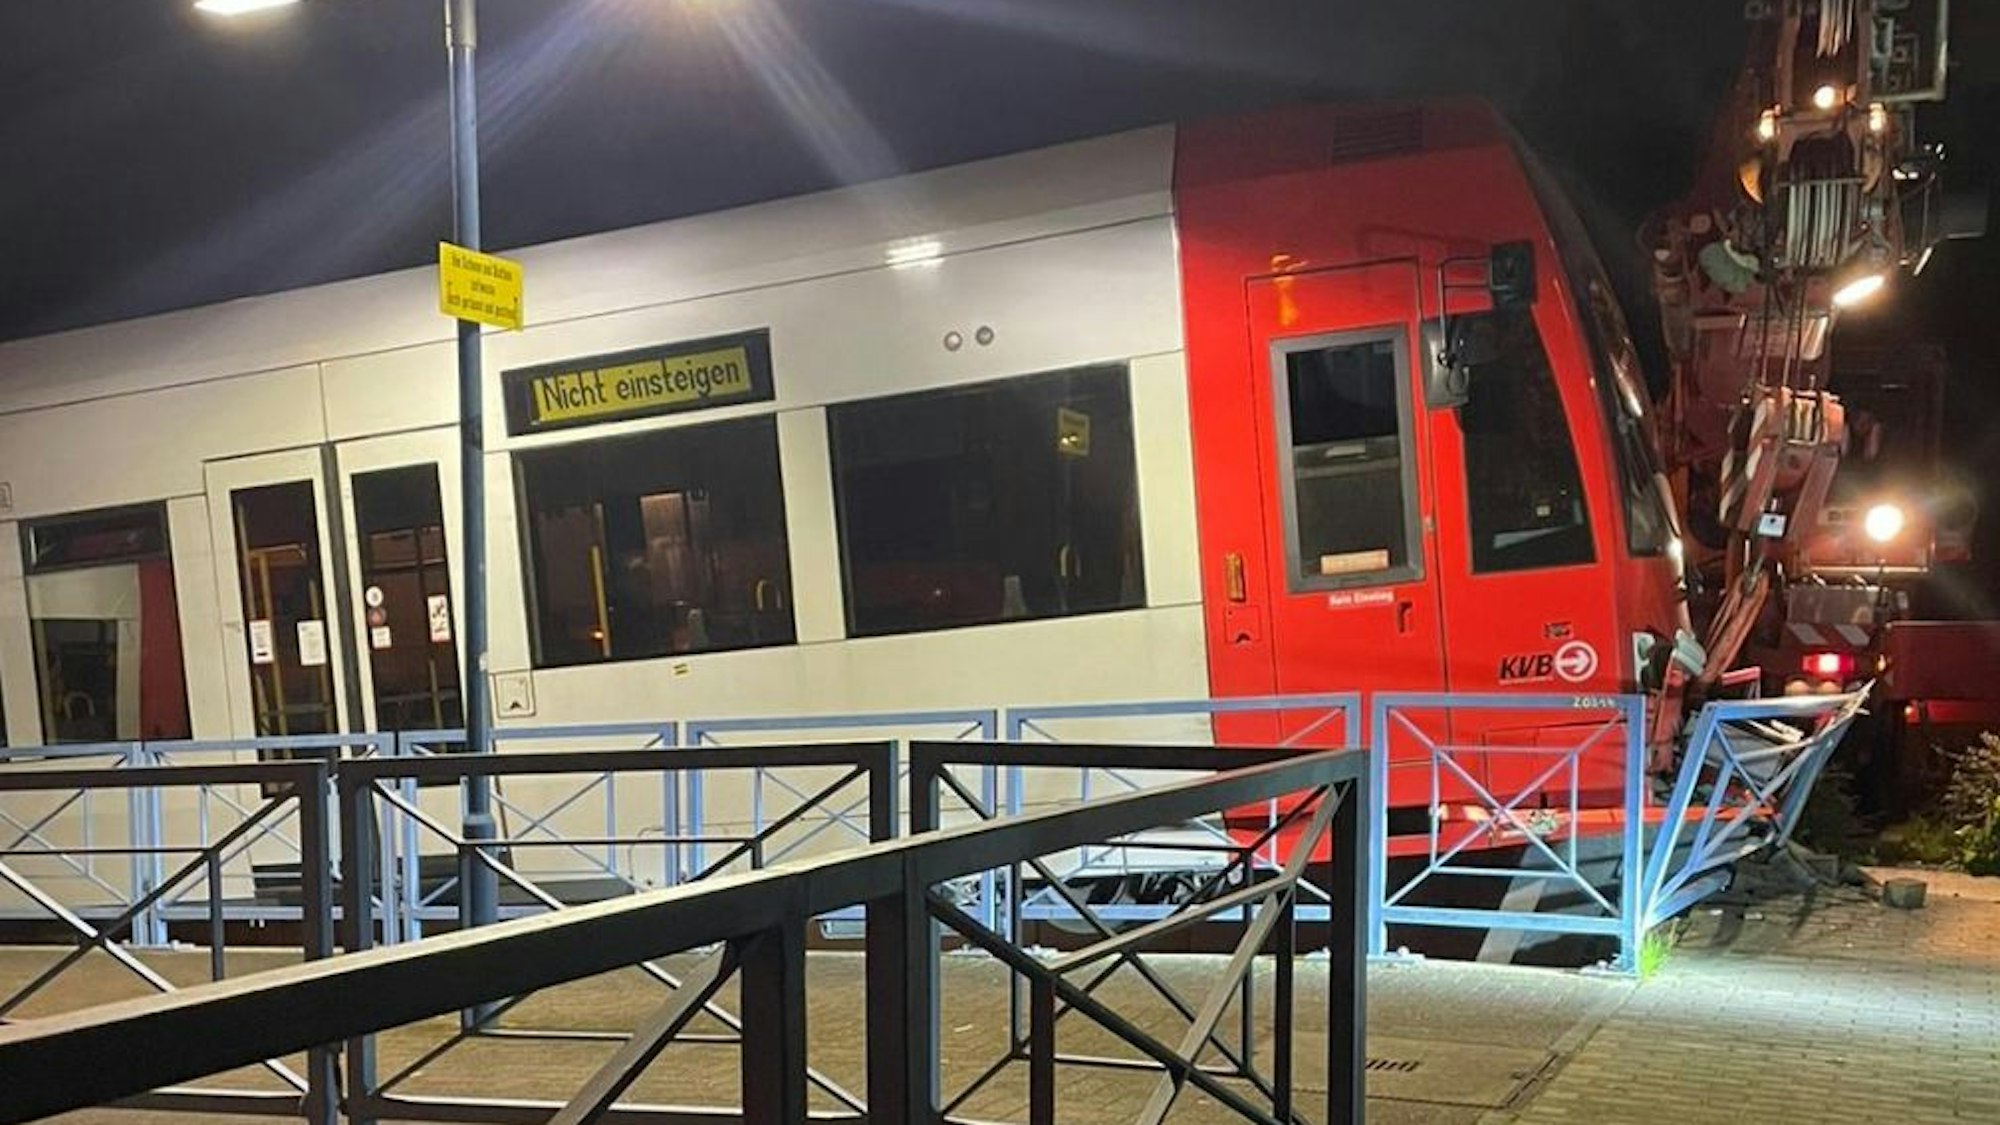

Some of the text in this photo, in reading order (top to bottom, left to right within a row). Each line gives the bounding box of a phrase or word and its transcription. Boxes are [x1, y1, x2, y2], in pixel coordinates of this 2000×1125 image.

[541, 357, 740, 412] Nicht einsteigen
[1500, 654, 1554, 680] KVB
